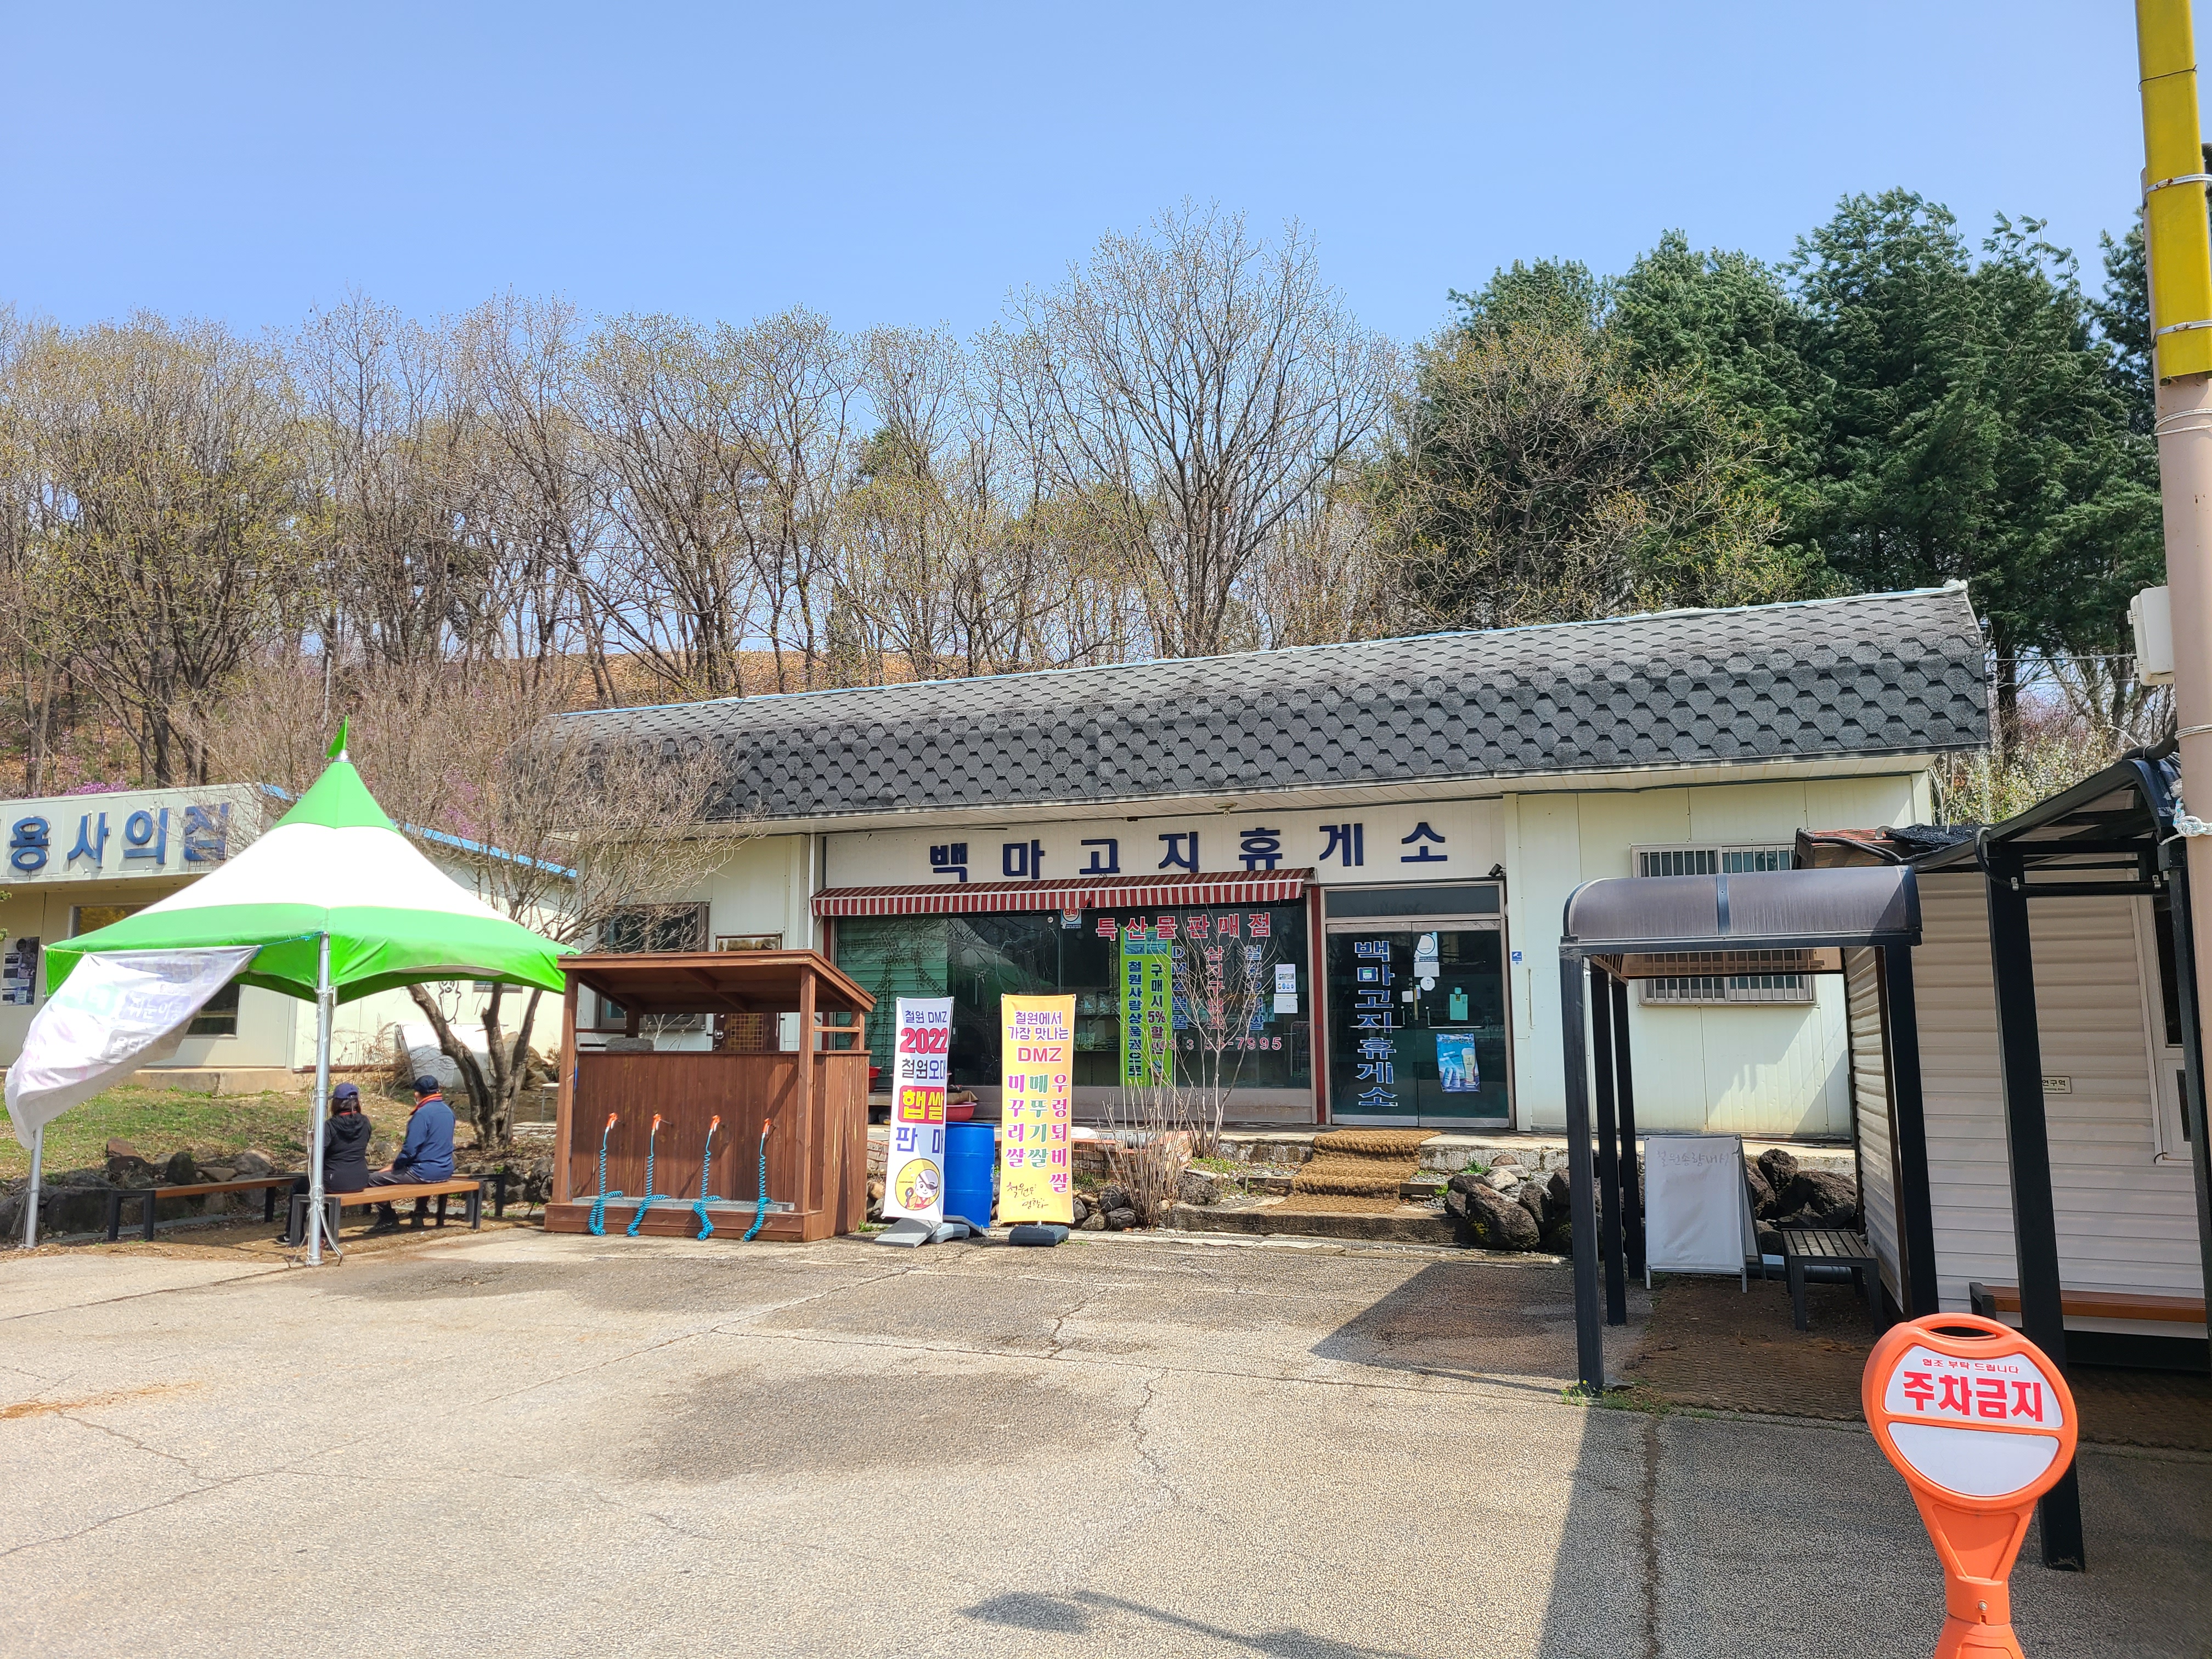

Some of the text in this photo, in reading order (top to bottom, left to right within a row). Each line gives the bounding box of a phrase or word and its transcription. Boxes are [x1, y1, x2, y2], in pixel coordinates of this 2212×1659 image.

[929, 821, 1448, 883] 백마고지휴게소
[1096, 912, 1271, 942] 특산물판매점
[905, 1010, 947, 1024] 철원 DMZ
[1016, 1011, 1062, 1025] 철원에서
[1355, 941, 1398, 1107] 백마고지휴게소
[900, 1027, 948, 1054] 2022
[1008, 1026, 1069, 1040] 가장 맛나는
[1018, 1047, 1062, 1062] DMZ
[902, 1089, 944, 1120] 햅쌀
[1922, 1358, 2019, 1374] 협조 부탁 드립니다
[1903, 1370, 2044, 1423] 주차금지
